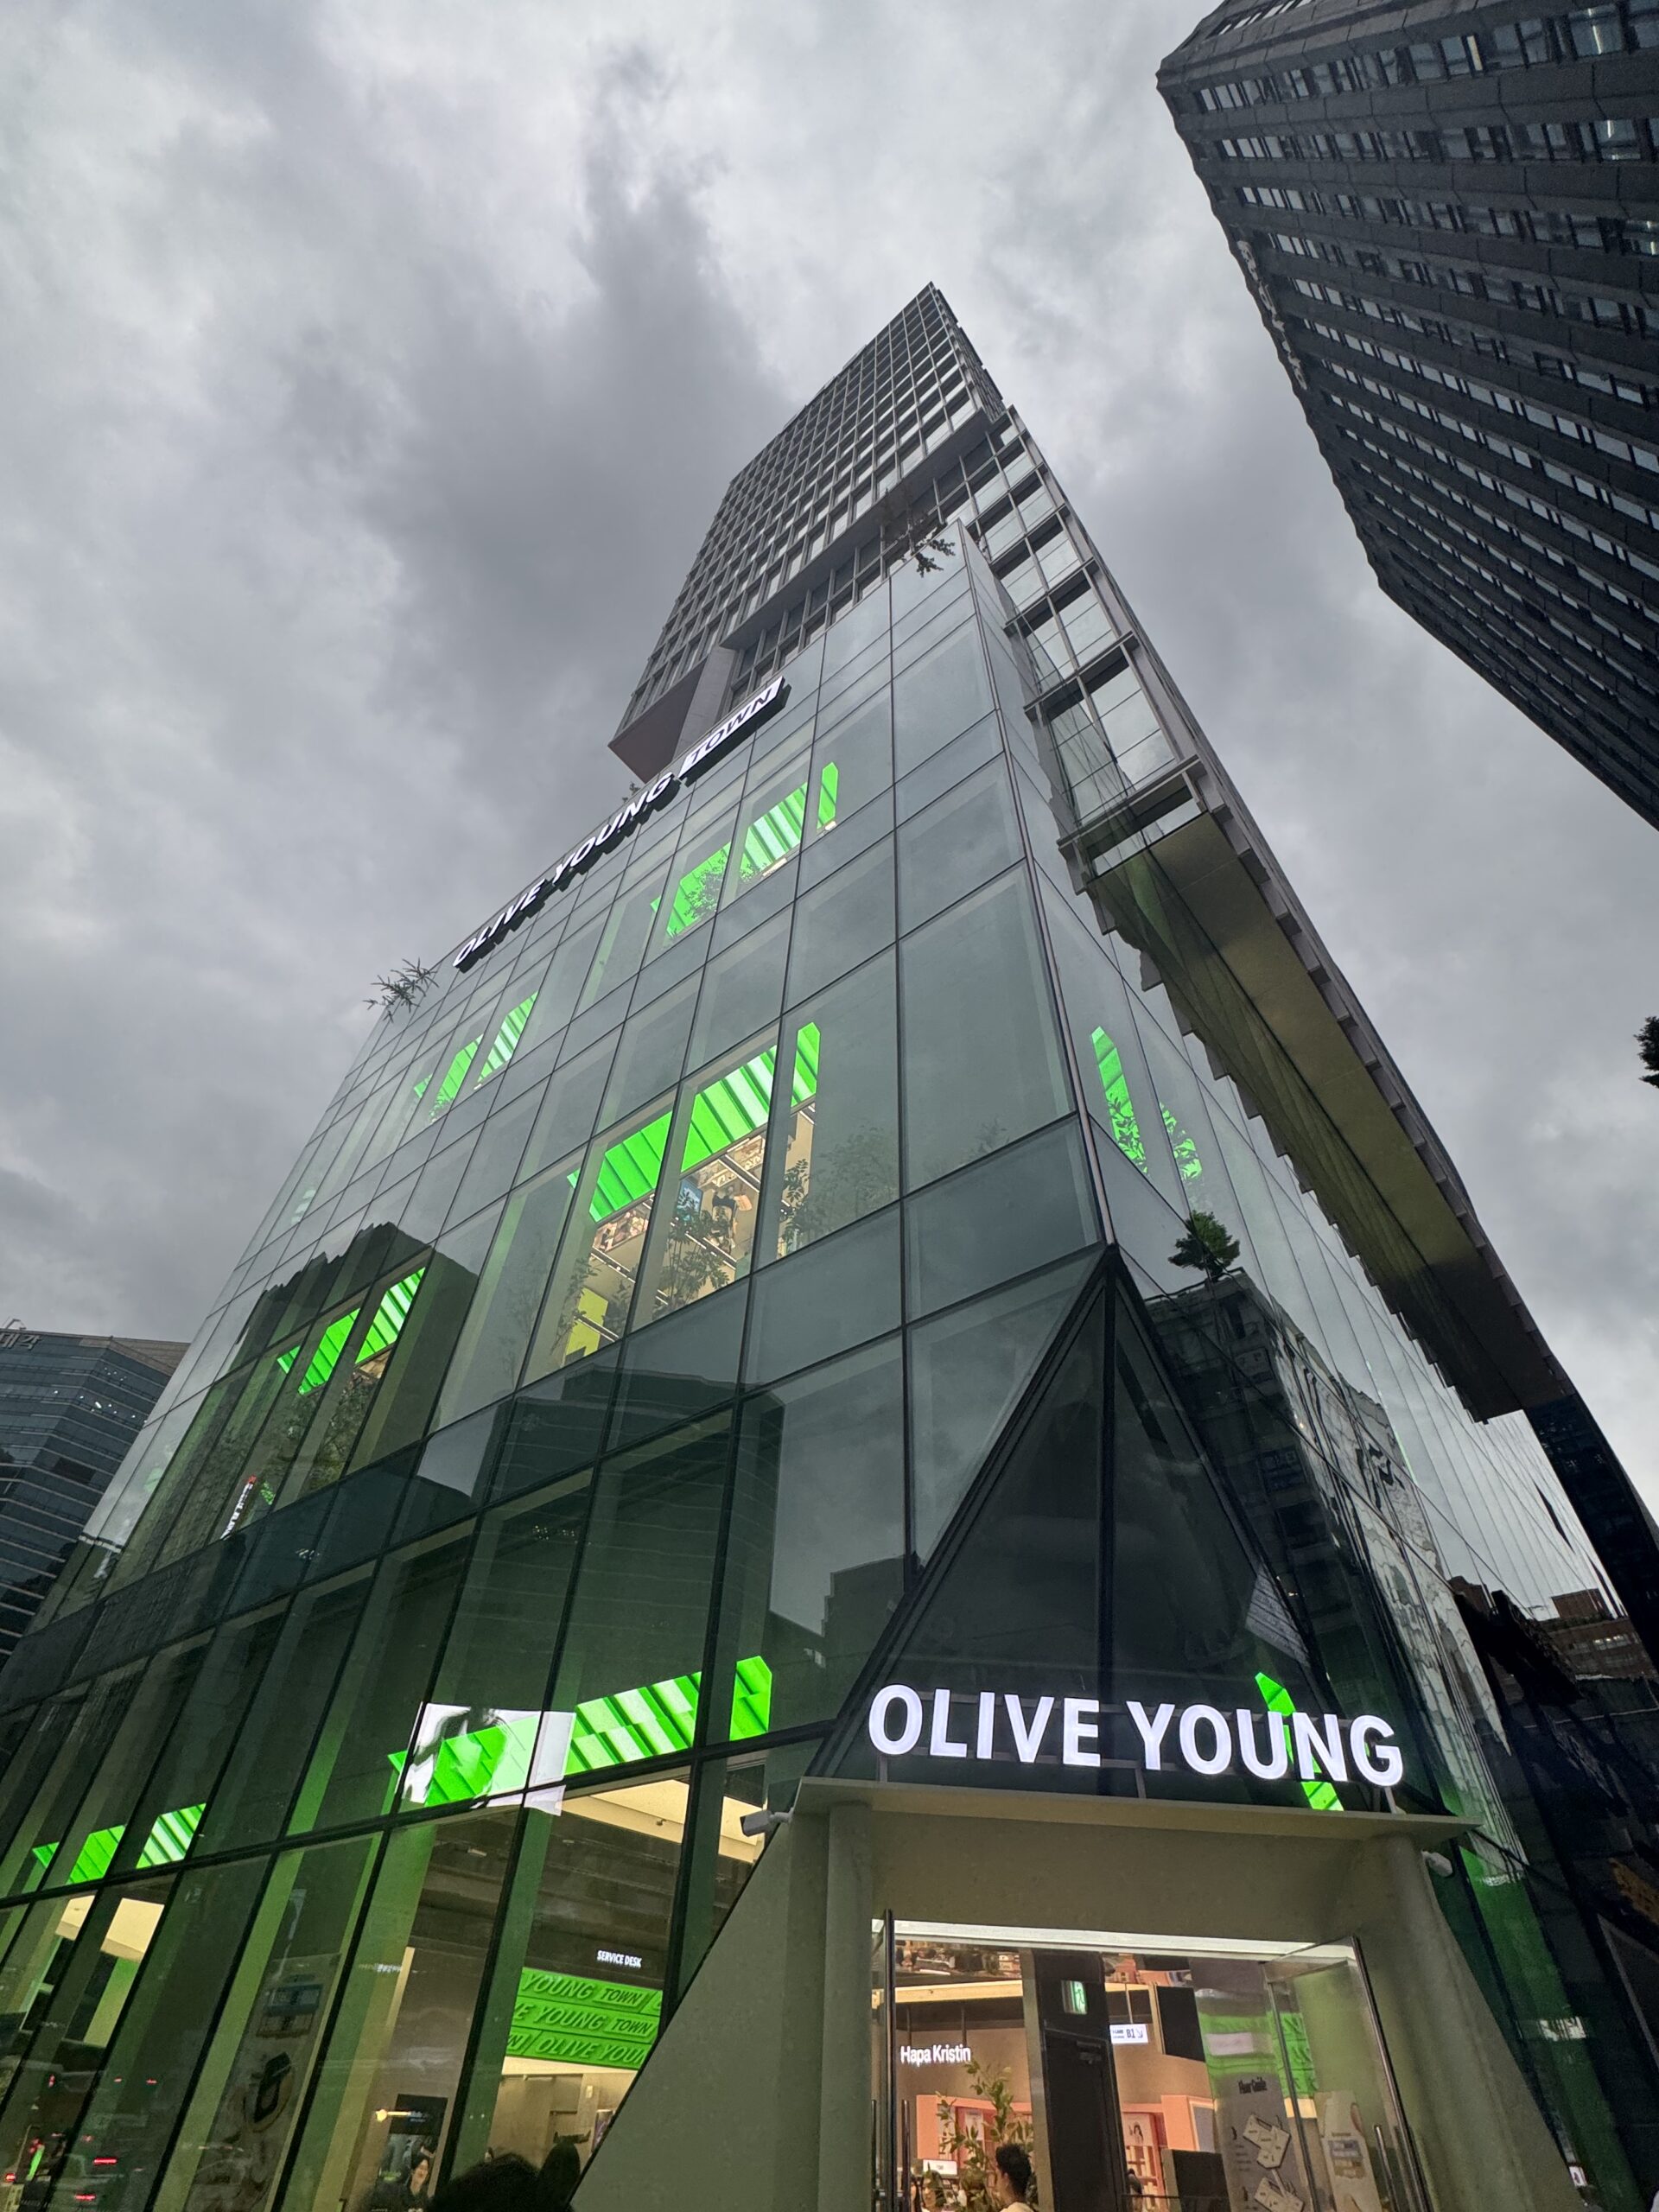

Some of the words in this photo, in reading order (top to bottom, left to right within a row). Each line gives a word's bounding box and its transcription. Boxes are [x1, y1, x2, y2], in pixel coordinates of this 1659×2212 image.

[453, 878, 550, 968] OLIVE
[552, 772, 675, 887] YOUNG
[690, 686, 774, 764] TOWN
[868, 1683, 1101, 1767] OLIVE
[1127, 1700, 1403, 1787] YOUNG
[596, 1949, 625, 1965] SERVICE
[624, 1955, 643, 1968] DESK
[522, 1973, 595, 2000] YOUNG
[601, 1987, 643, 2005] TOWN
[533, 2005, 606, 2031] YOUNG
[612, 2018, 654, 2036] TOWN
[536, 2036, 600, 2058] OLIVE
[900, 2045, 931, 2068] Hapa
[933, 2044, 971, 2063] Kristin
